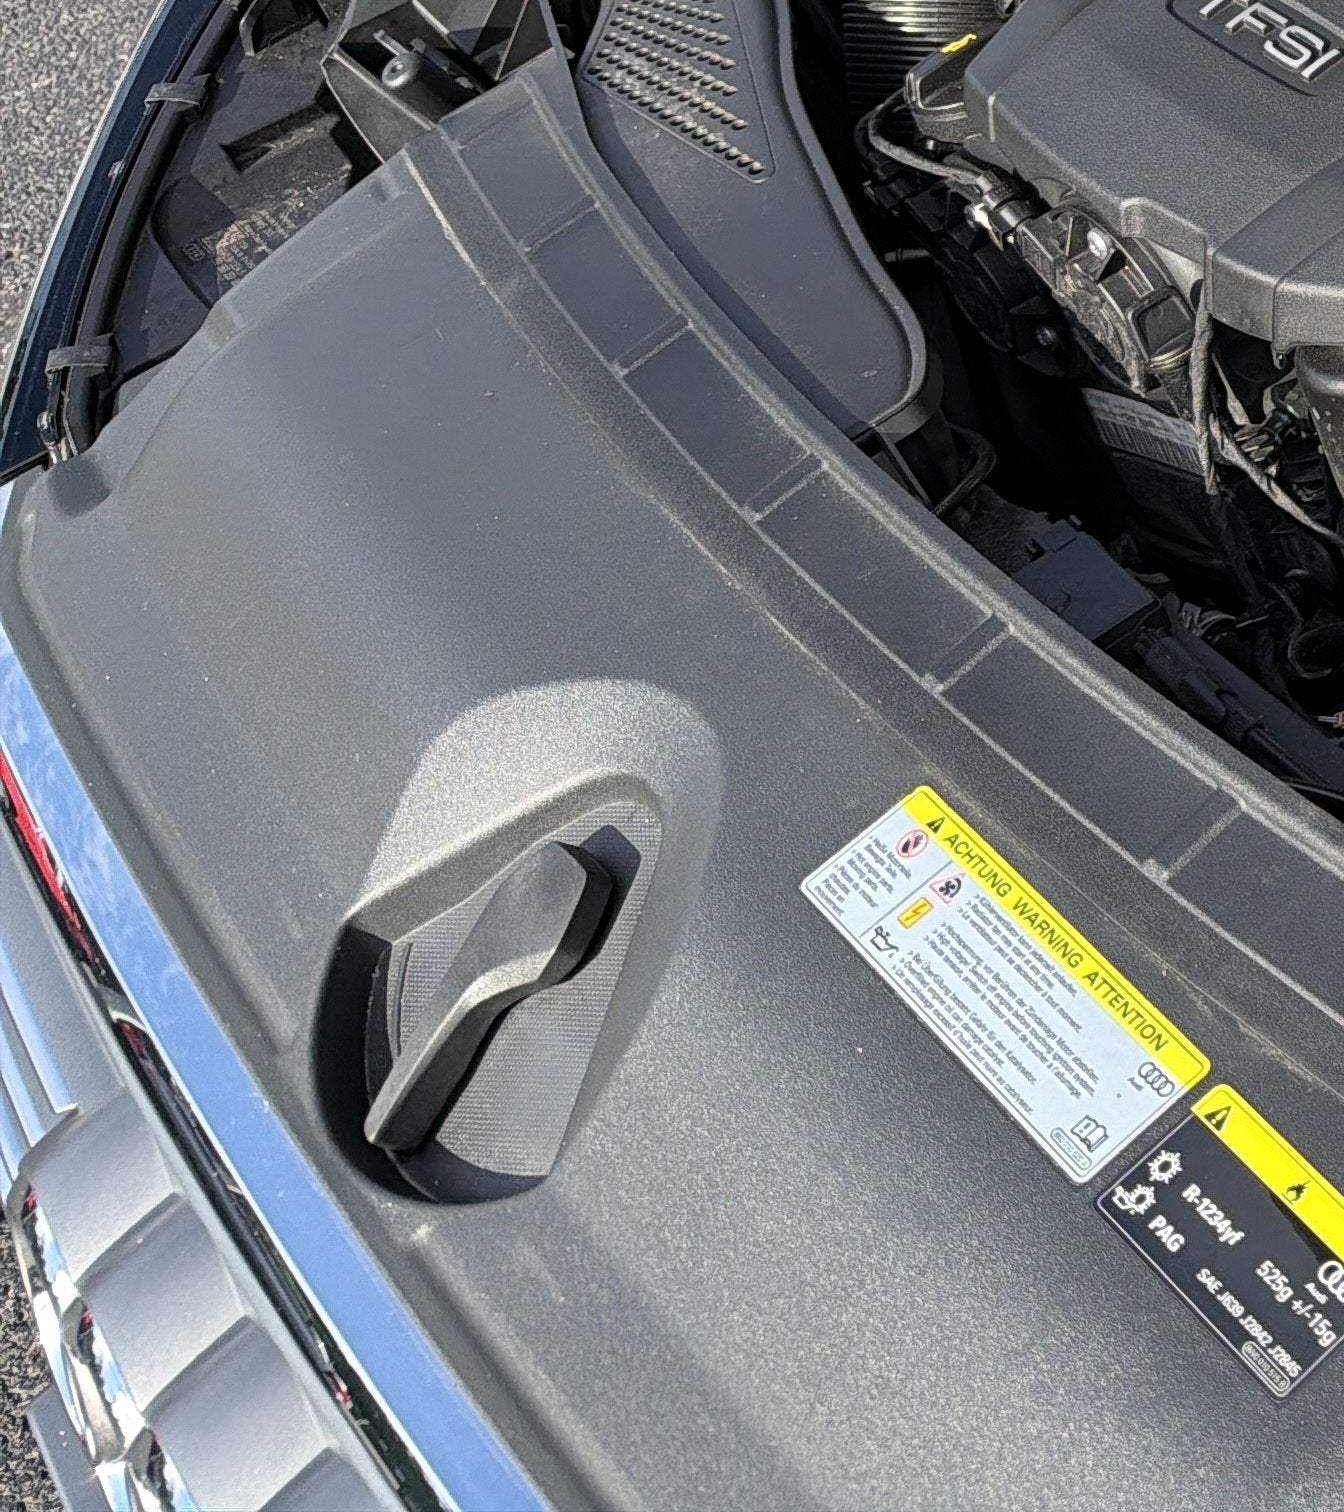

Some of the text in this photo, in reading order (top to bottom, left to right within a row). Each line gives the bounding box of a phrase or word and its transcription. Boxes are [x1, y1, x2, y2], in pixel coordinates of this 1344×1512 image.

[942, 830, 1169, 1052] ACHTUNG WARNING ATTENTION
[1127, 1075, 1144, 1091] Audi
[1147, 1214, 1303, 1378] PAG SAE J639 J2842 J2845
[1181, 1182, 1338, 1348] R-1234yf 525g +/-15g
[1303, 1279, 1329, 1305] Audi
